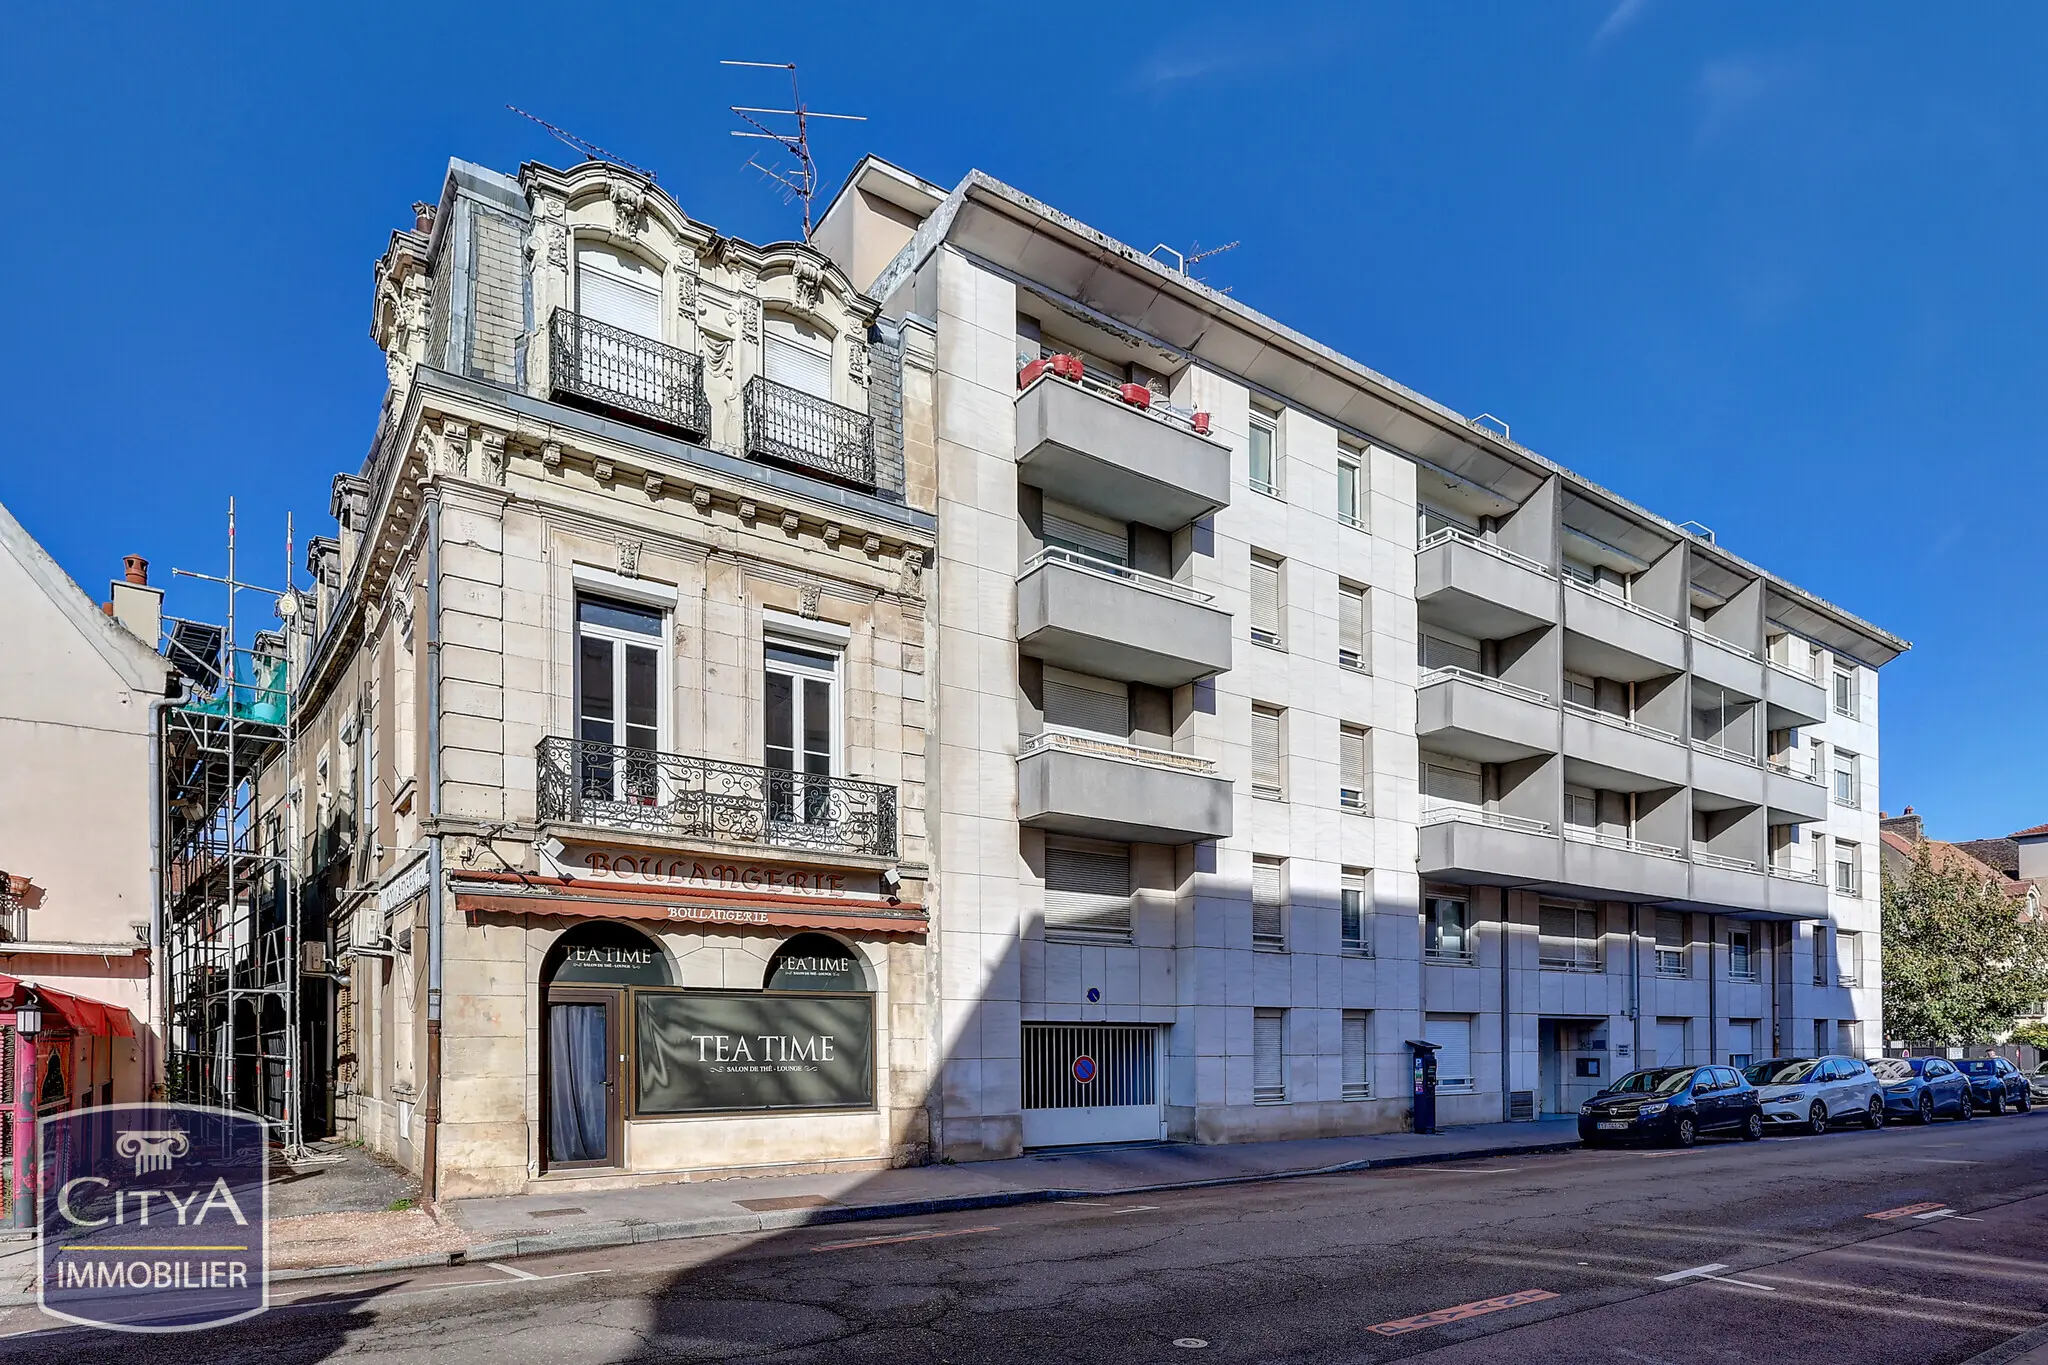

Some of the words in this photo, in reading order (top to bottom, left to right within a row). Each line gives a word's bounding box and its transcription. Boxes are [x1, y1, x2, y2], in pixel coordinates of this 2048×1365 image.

[584, 852, 848, 897] BOULANGERIE
[667, 907, 769, 923] BOULANGERIE
[562, 945, 601, 961] TEA
[602, 946, 652, 964] TIME
[776, 955, 807, 970] TEA
[808, 956, 849, 972] TIME
[691, 1035, 756, 1062] TEA
[757, 1035, 835, 1062] TIME
